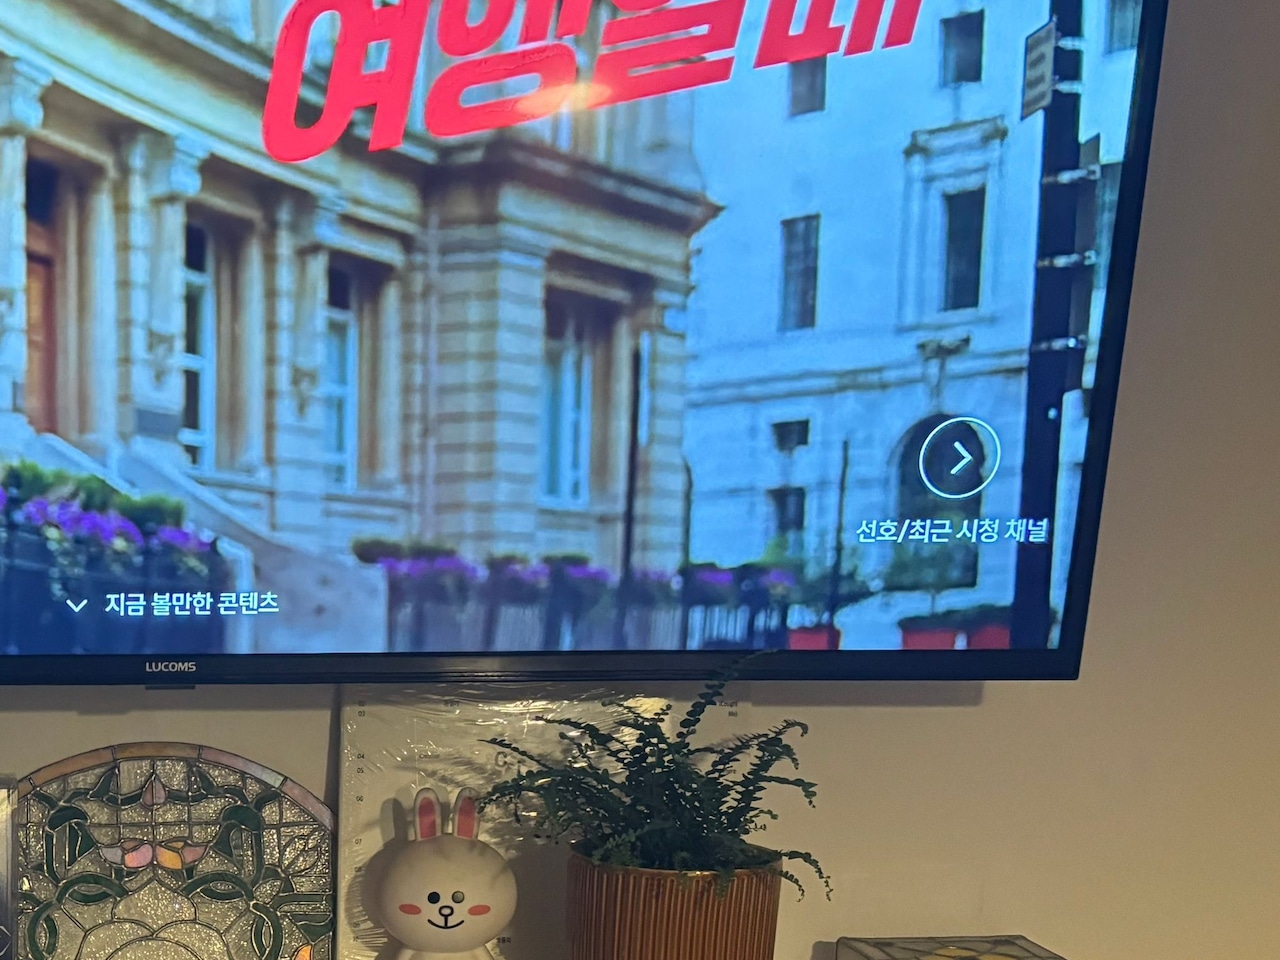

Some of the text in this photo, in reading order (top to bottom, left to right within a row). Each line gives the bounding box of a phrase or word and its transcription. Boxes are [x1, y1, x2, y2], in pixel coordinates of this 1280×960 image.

[855, 517, 1049, 544] 선호/최근 시청 채널
[104, 591, 280, 617] 지금 볼만한 콘텐츠
[145, 661, 197, 672] LUCOMS
